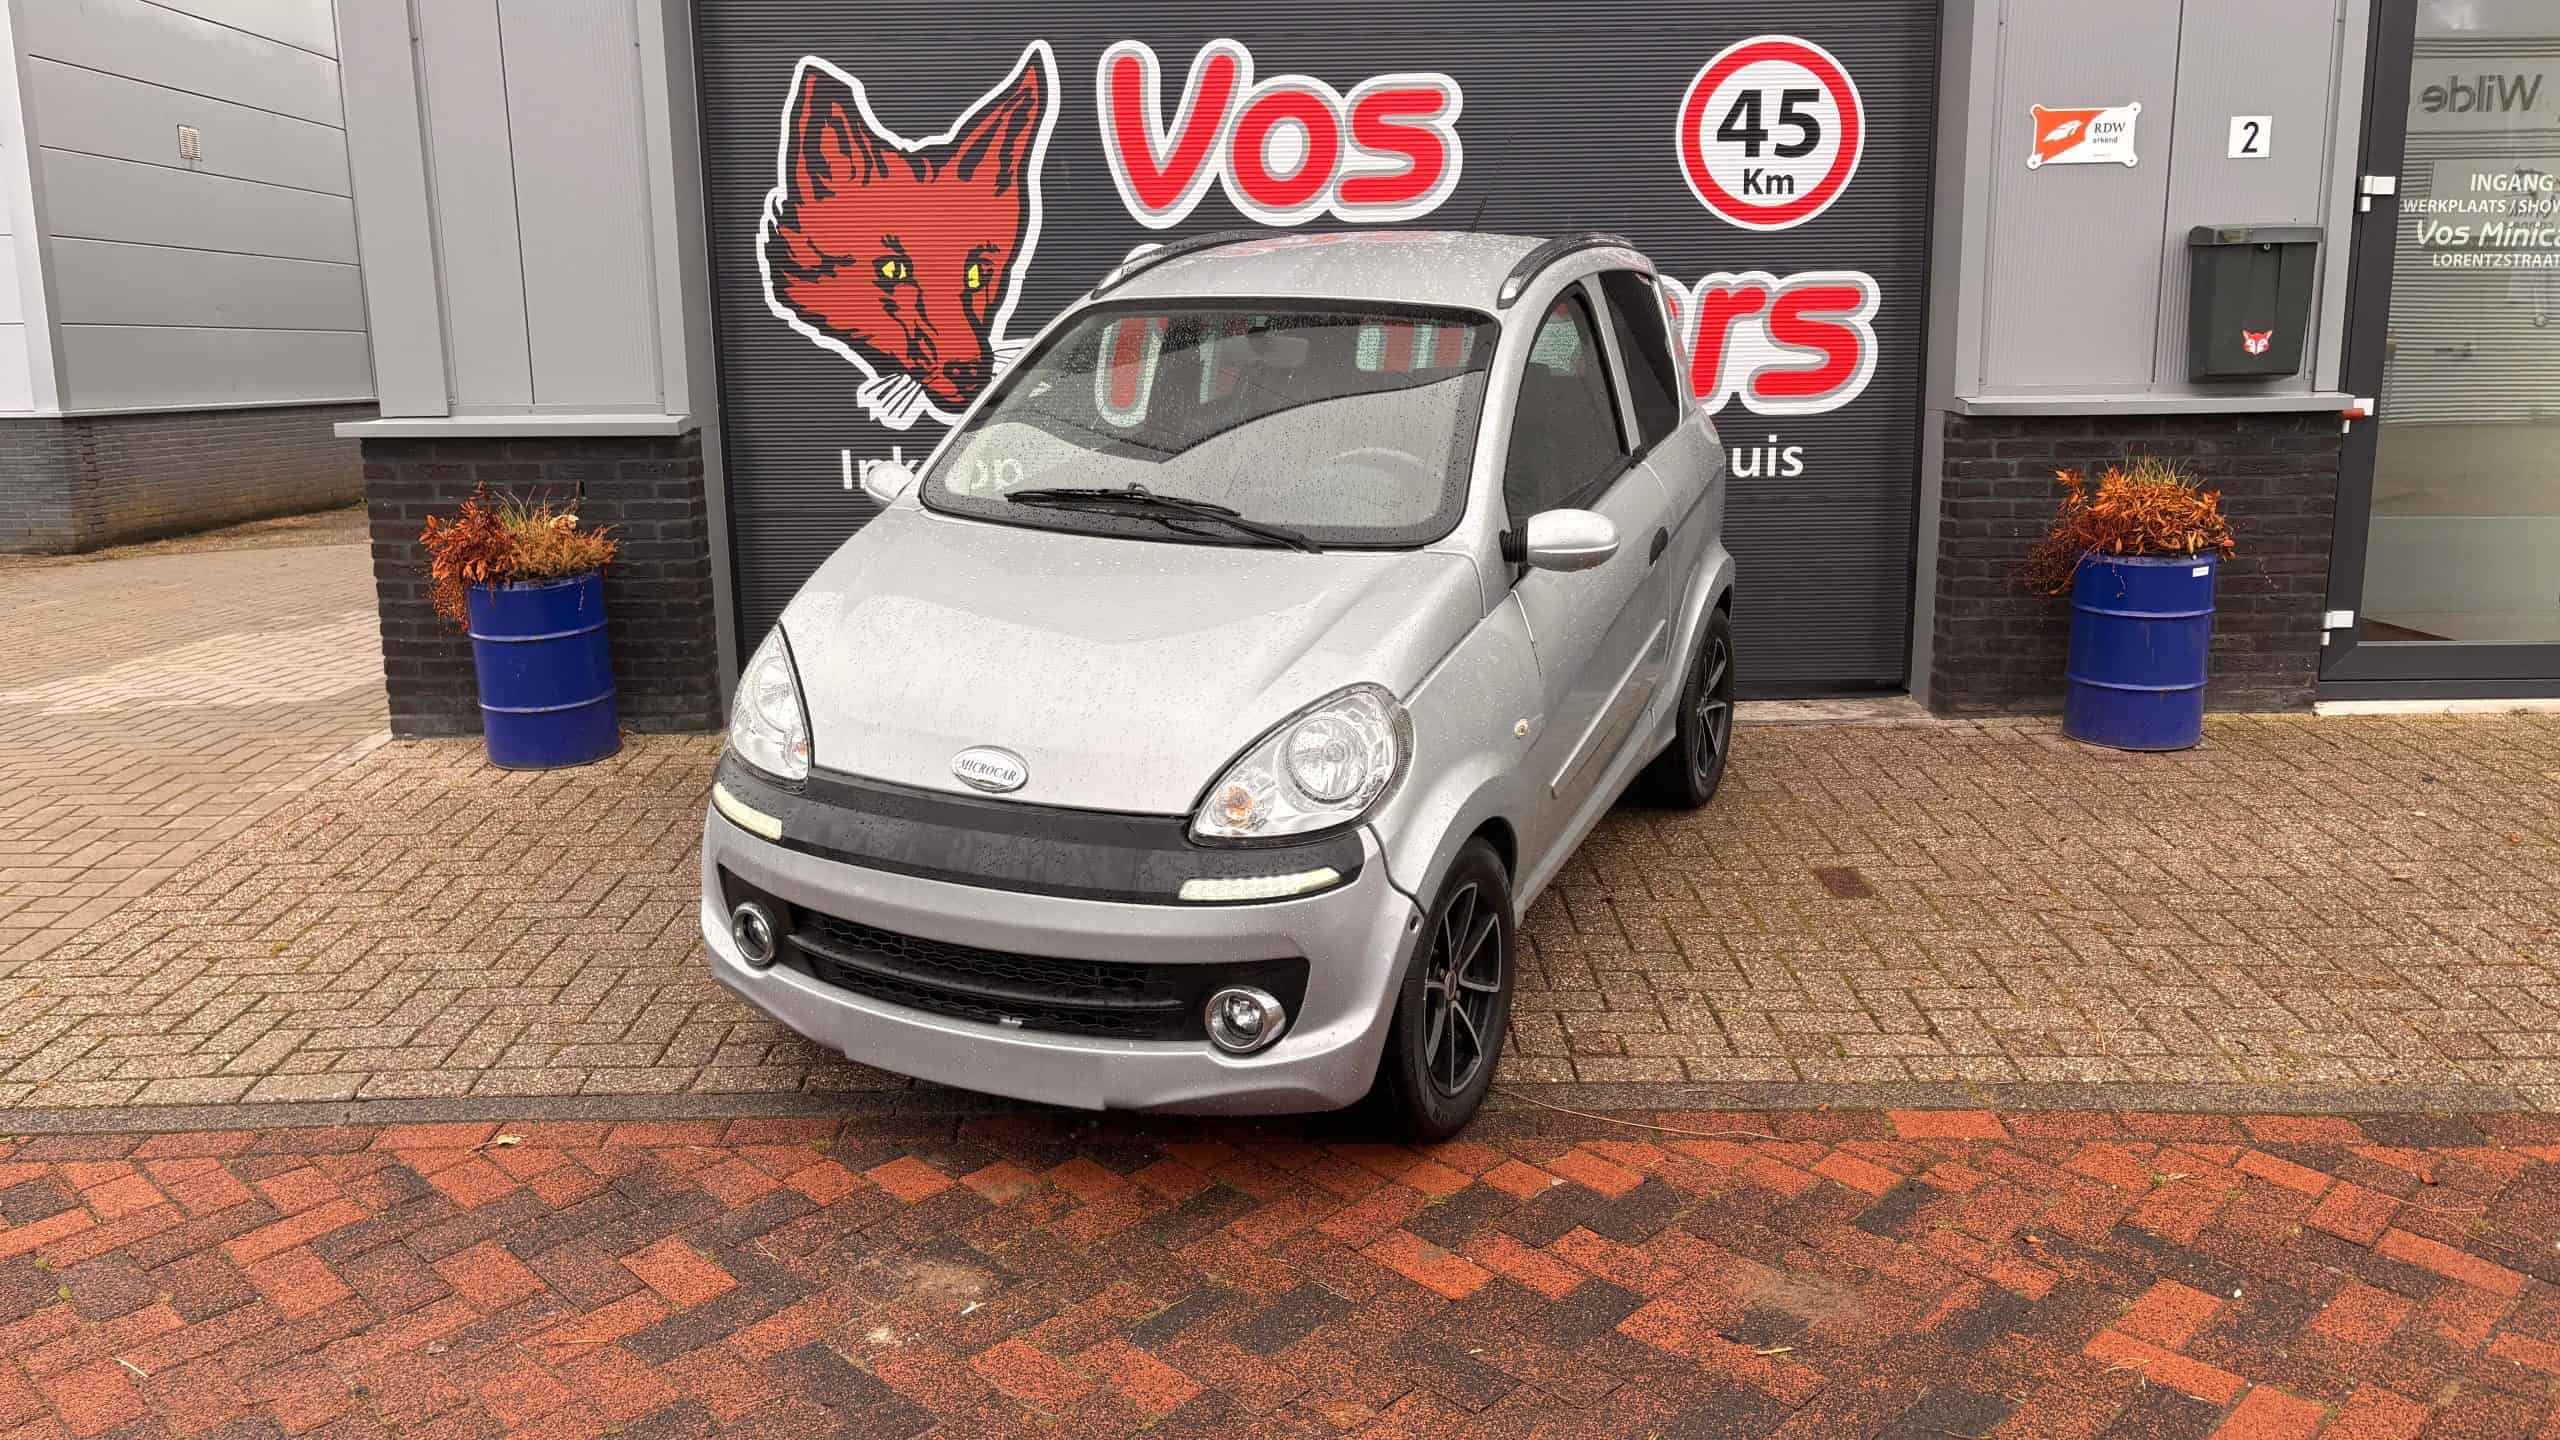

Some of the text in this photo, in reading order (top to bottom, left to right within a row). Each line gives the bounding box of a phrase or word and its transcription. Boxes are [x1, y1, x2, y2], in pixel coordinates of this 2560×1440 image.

[1103, 45, 1457, 219] Vos
[1716, 88, 1821, 158] 45
[2094, 121, 2126, 133] RDW
[2242, 121, 2260, 153] 2
[1743, 168, 1794, 195] Km
[2470, 173, 2554, 192] INGANG
[2403, 199, 2506, 213] WERKPLAATS
[2417, 220, 2471, 245] Vos
[1660, 270, 1880, 414] rs
[1731, 434, 1804, 477] uis
[960, 758, 1017, 781] MICROCAR
